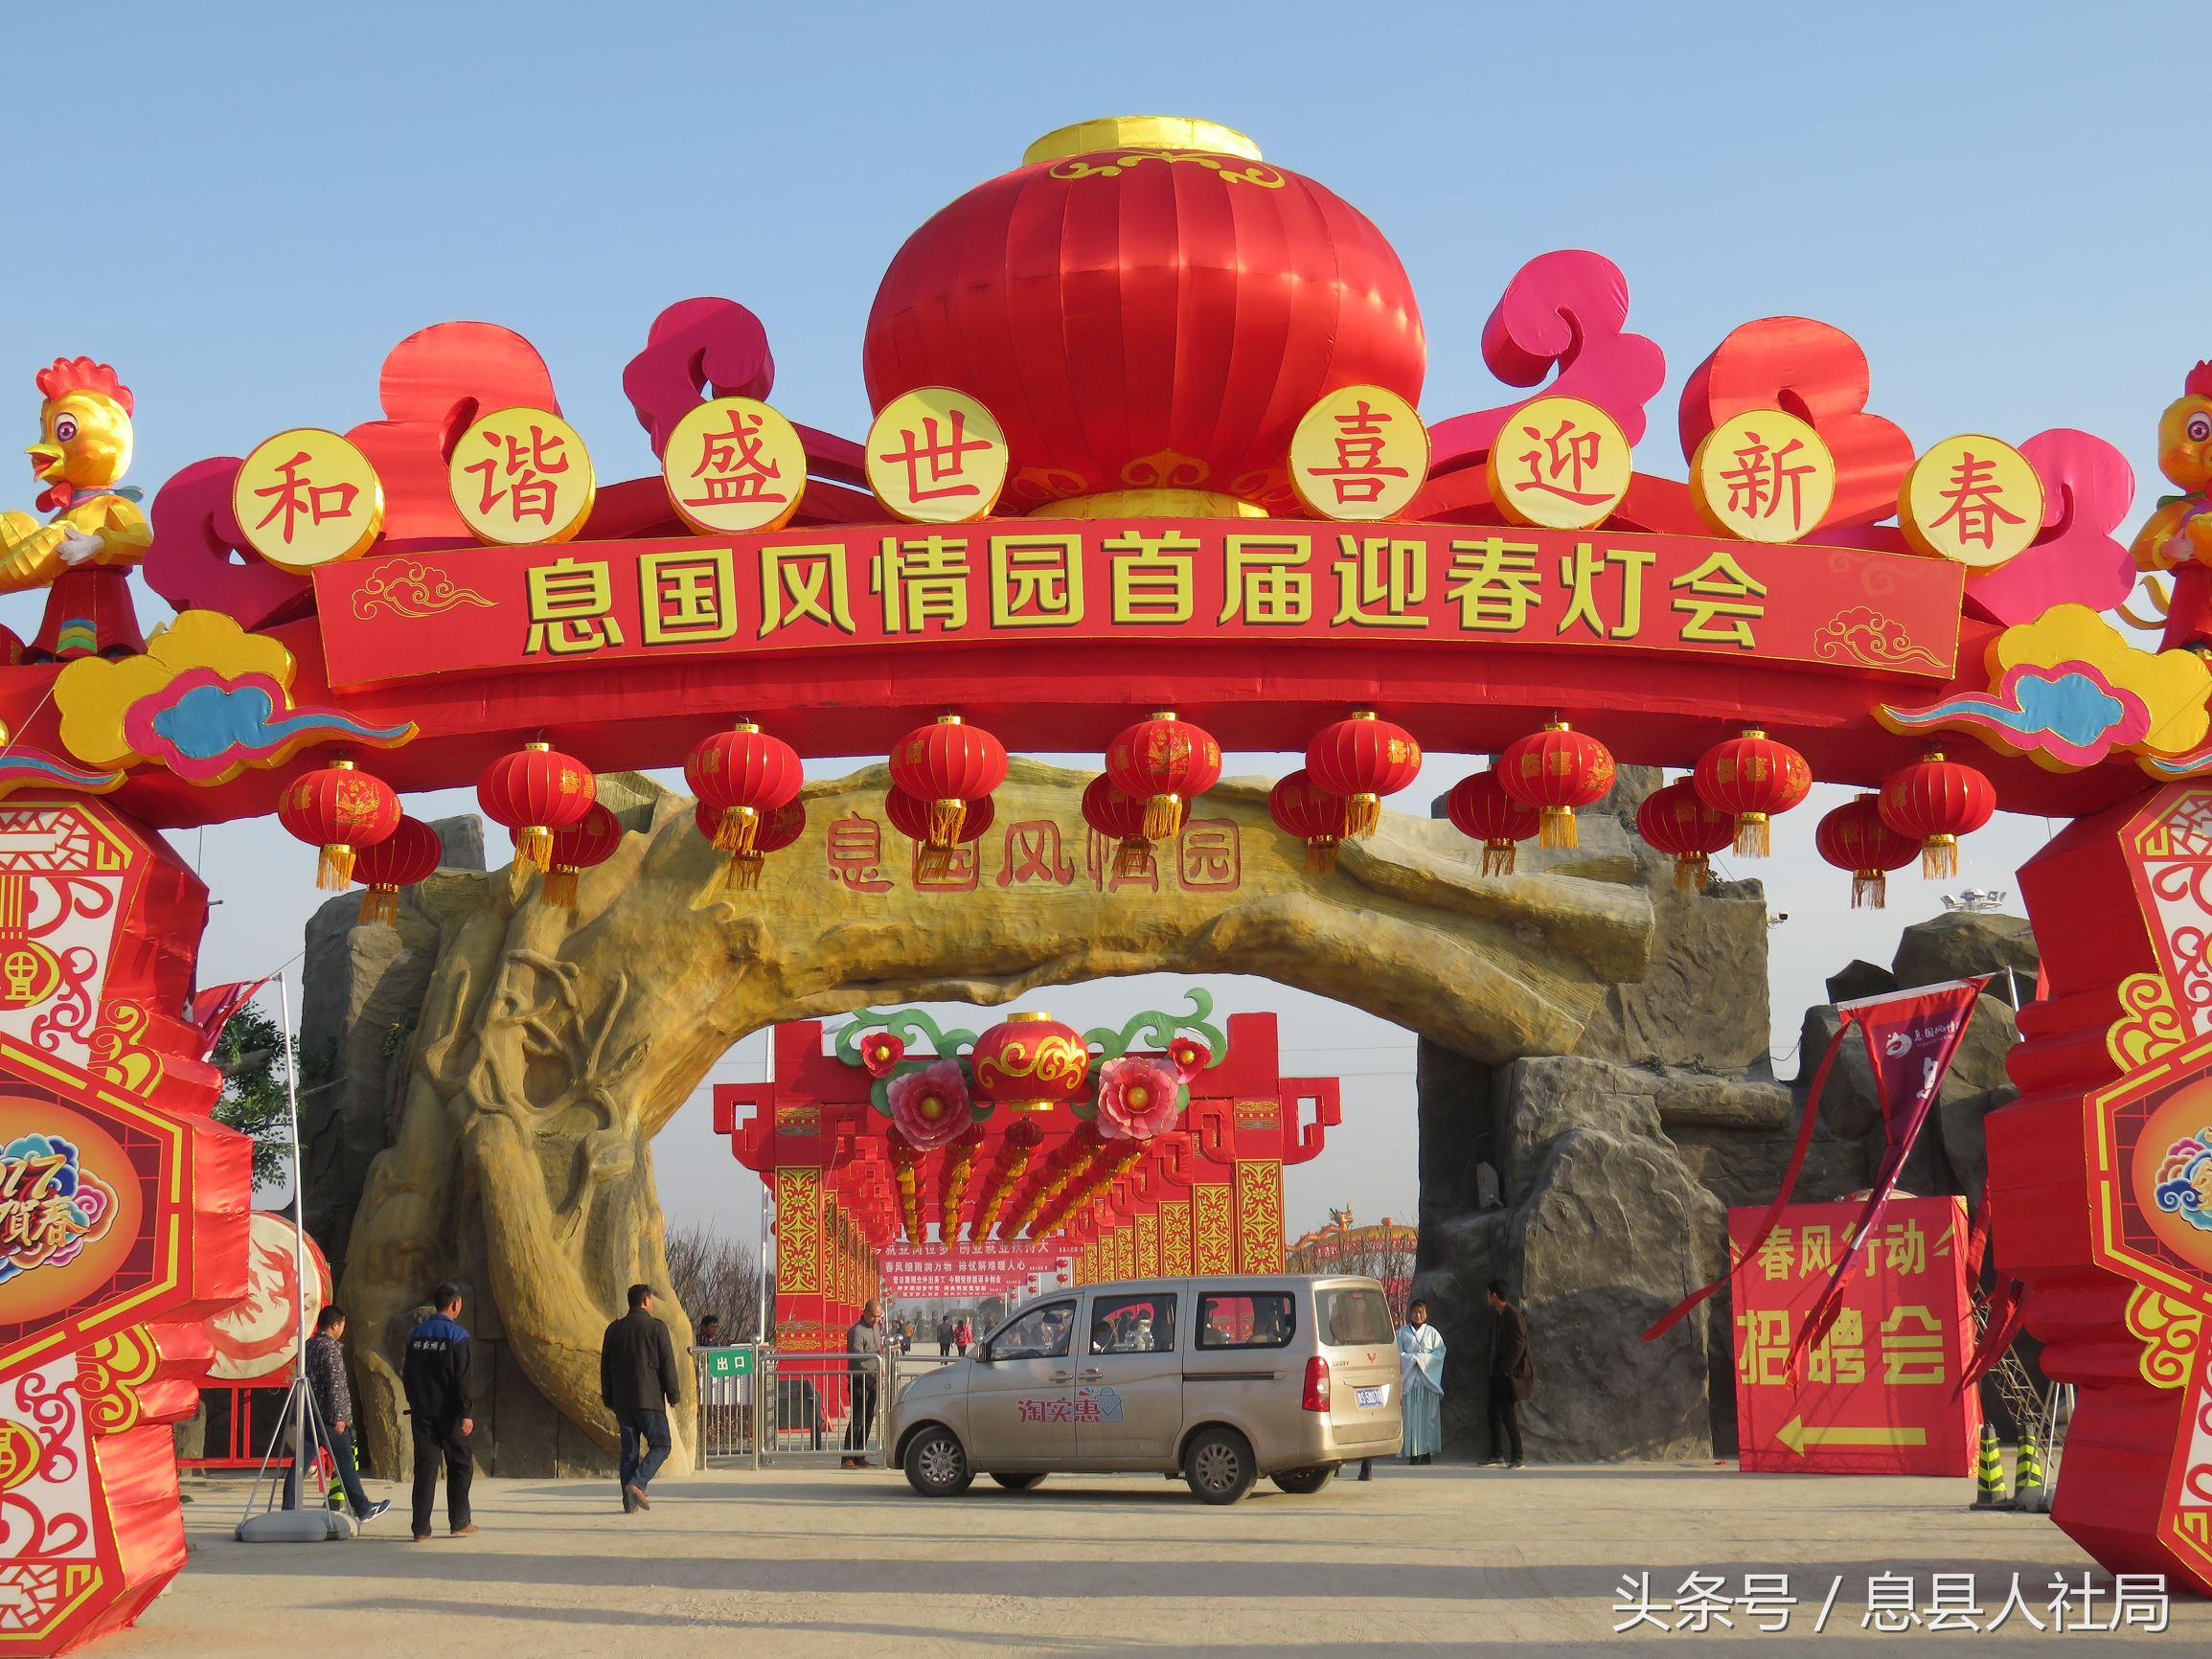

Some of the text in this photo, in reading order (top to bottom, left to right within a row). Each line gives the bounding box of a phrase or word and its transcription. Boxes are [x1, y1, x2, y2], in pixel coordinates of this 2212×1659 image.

[255, 400, 2027, 550] 和 谐 盛 世 喜 迎 新 春
[525, 531, 1769, 655] 息国风情园首届迎春灯会
[0, 1154, 66, 1199] 17
[885, 1261, 952, 1273] 春风细雨润万物
[717, 1355, 745, 1371] 出口
[1736, 1305, 1946, 1386] 招聘会
[1017, 1398, 1101, 1423] 淘实惠
